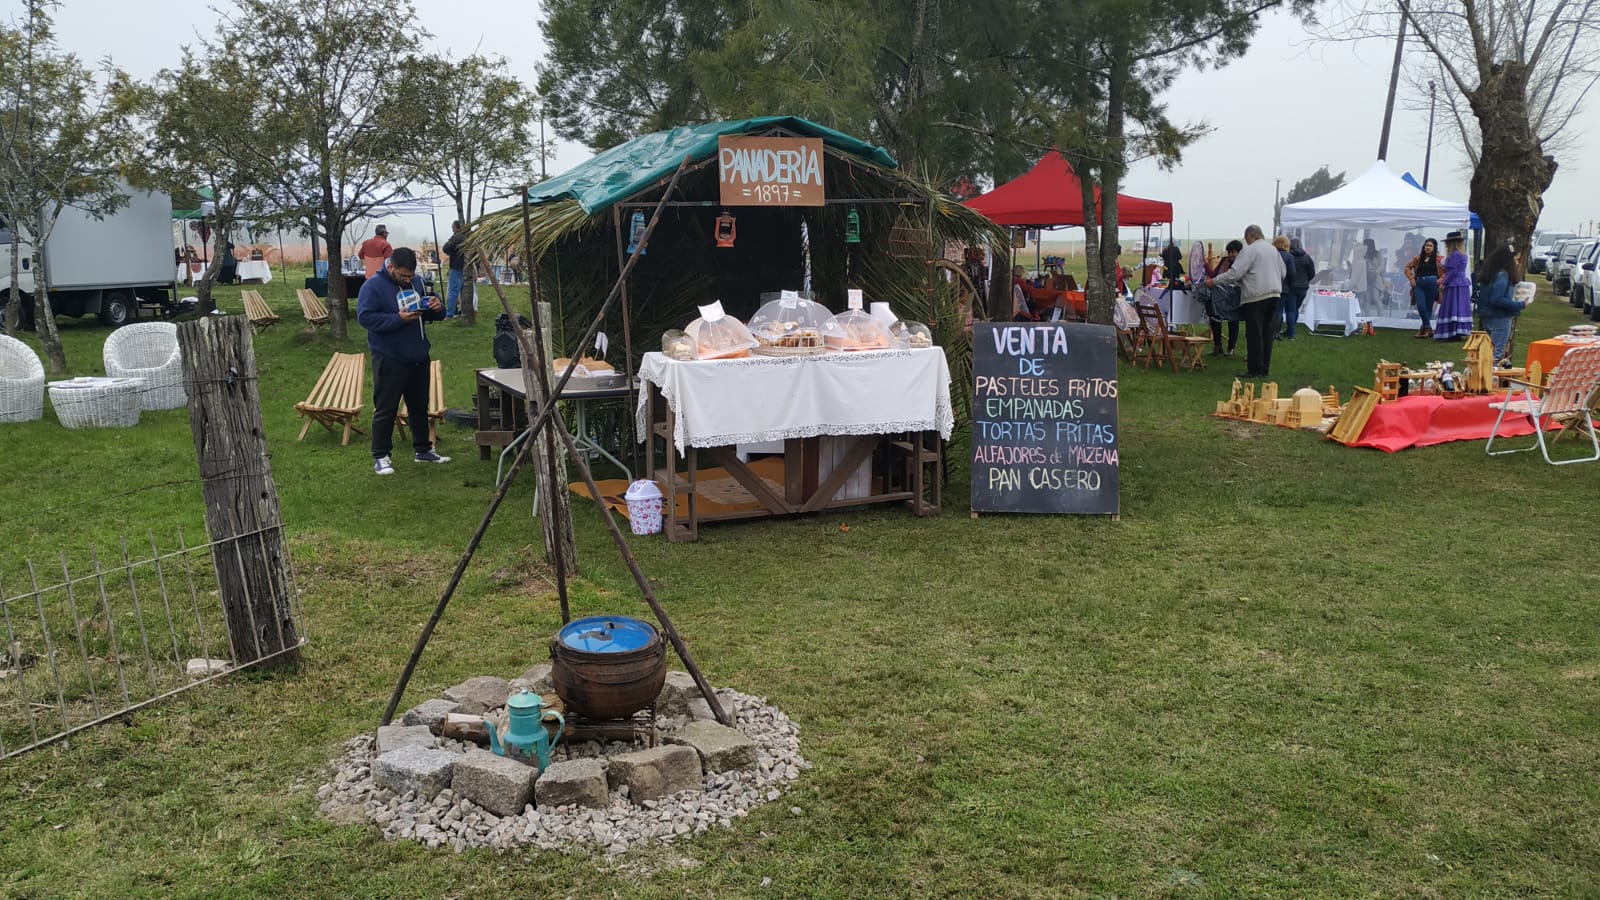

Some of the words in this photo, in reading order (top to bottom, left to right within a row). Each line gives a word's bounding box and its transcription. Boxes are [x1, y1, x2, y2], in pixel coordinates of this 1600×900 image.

[993, 326, 1069, 356] VENTA
[1019, 358, 1046, 376] DE
[975, 376, 1060, 397] PASTELES
[986, 398, 1084, 420] EMPANADAS
[976, 420, 1046, 442] TORTAS
[989, 467, 1021, 491] PAN
[1029, 467, 1101, 491] CASERO
